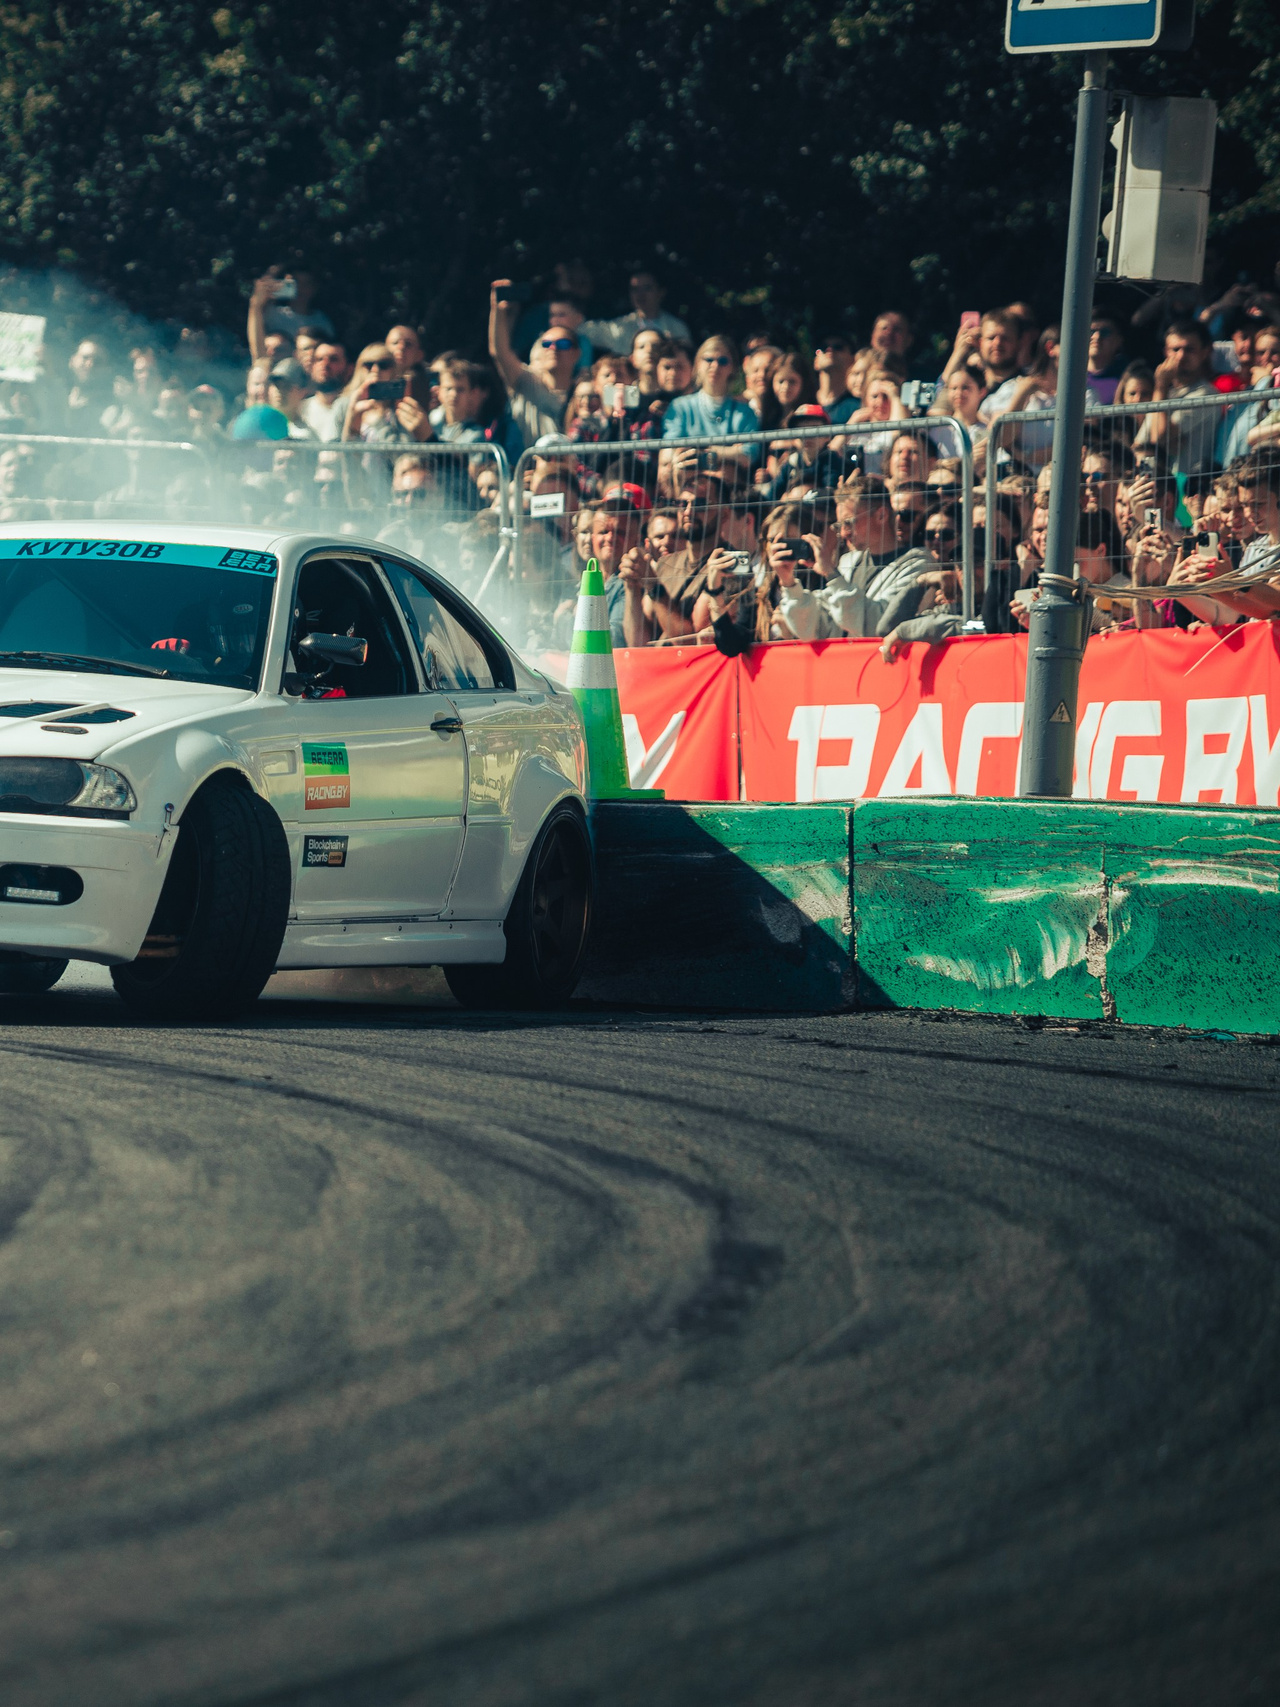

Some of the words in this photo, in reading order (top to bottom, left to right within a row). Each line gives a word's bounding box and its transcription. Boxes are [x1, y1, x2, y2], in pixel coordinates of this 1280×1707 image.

[15, 541, 166, 559] КУТУЗОВ
[230, 551, 277, 564] BET
[308, 839, 341, 850] Blockchain
[307, 851, 328, 864] Sports
